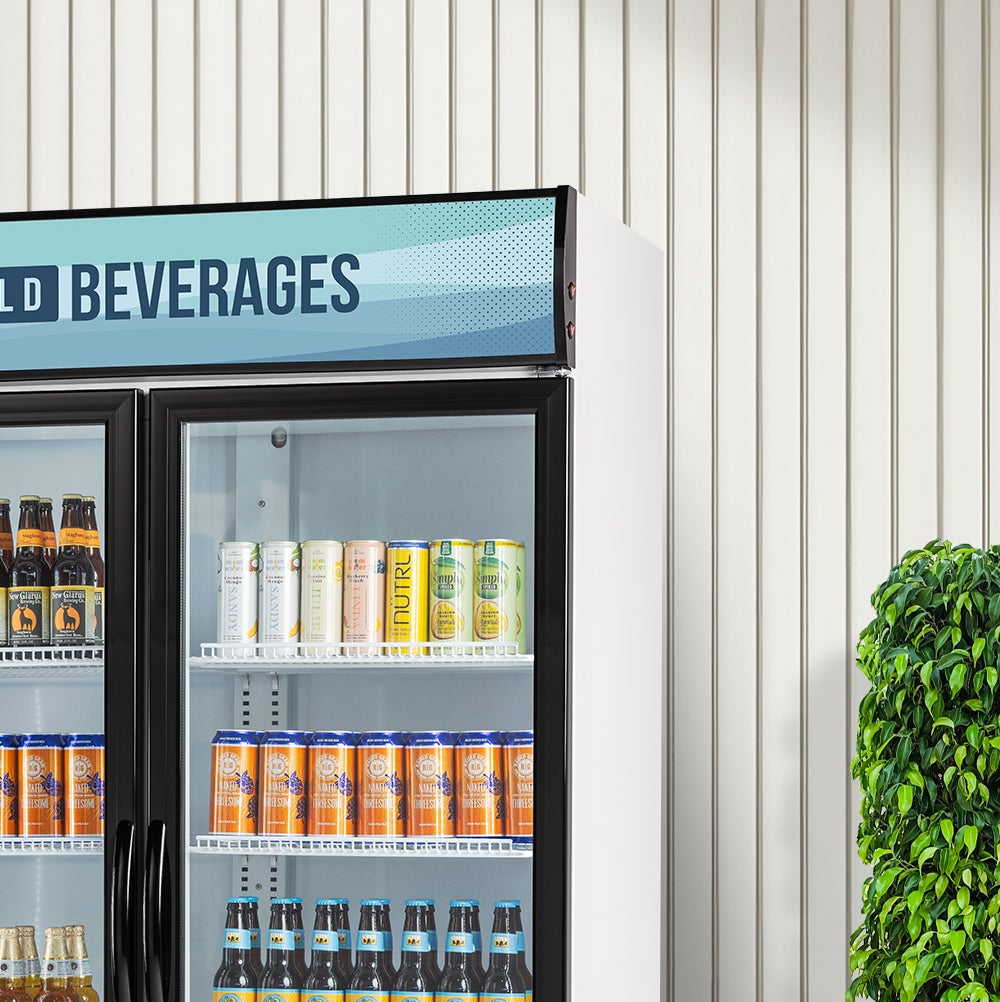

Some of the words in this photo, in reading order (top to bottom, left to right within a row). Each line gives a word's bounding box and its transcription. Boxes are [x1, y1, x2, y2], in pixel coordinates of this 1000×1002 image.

[71, 253, 361, 321] BEVERAGES
[228, 587, 238, 631] SANDY
[270, 586, 279, 631] SANDY
[352, 587, 361, 628] LINDA
